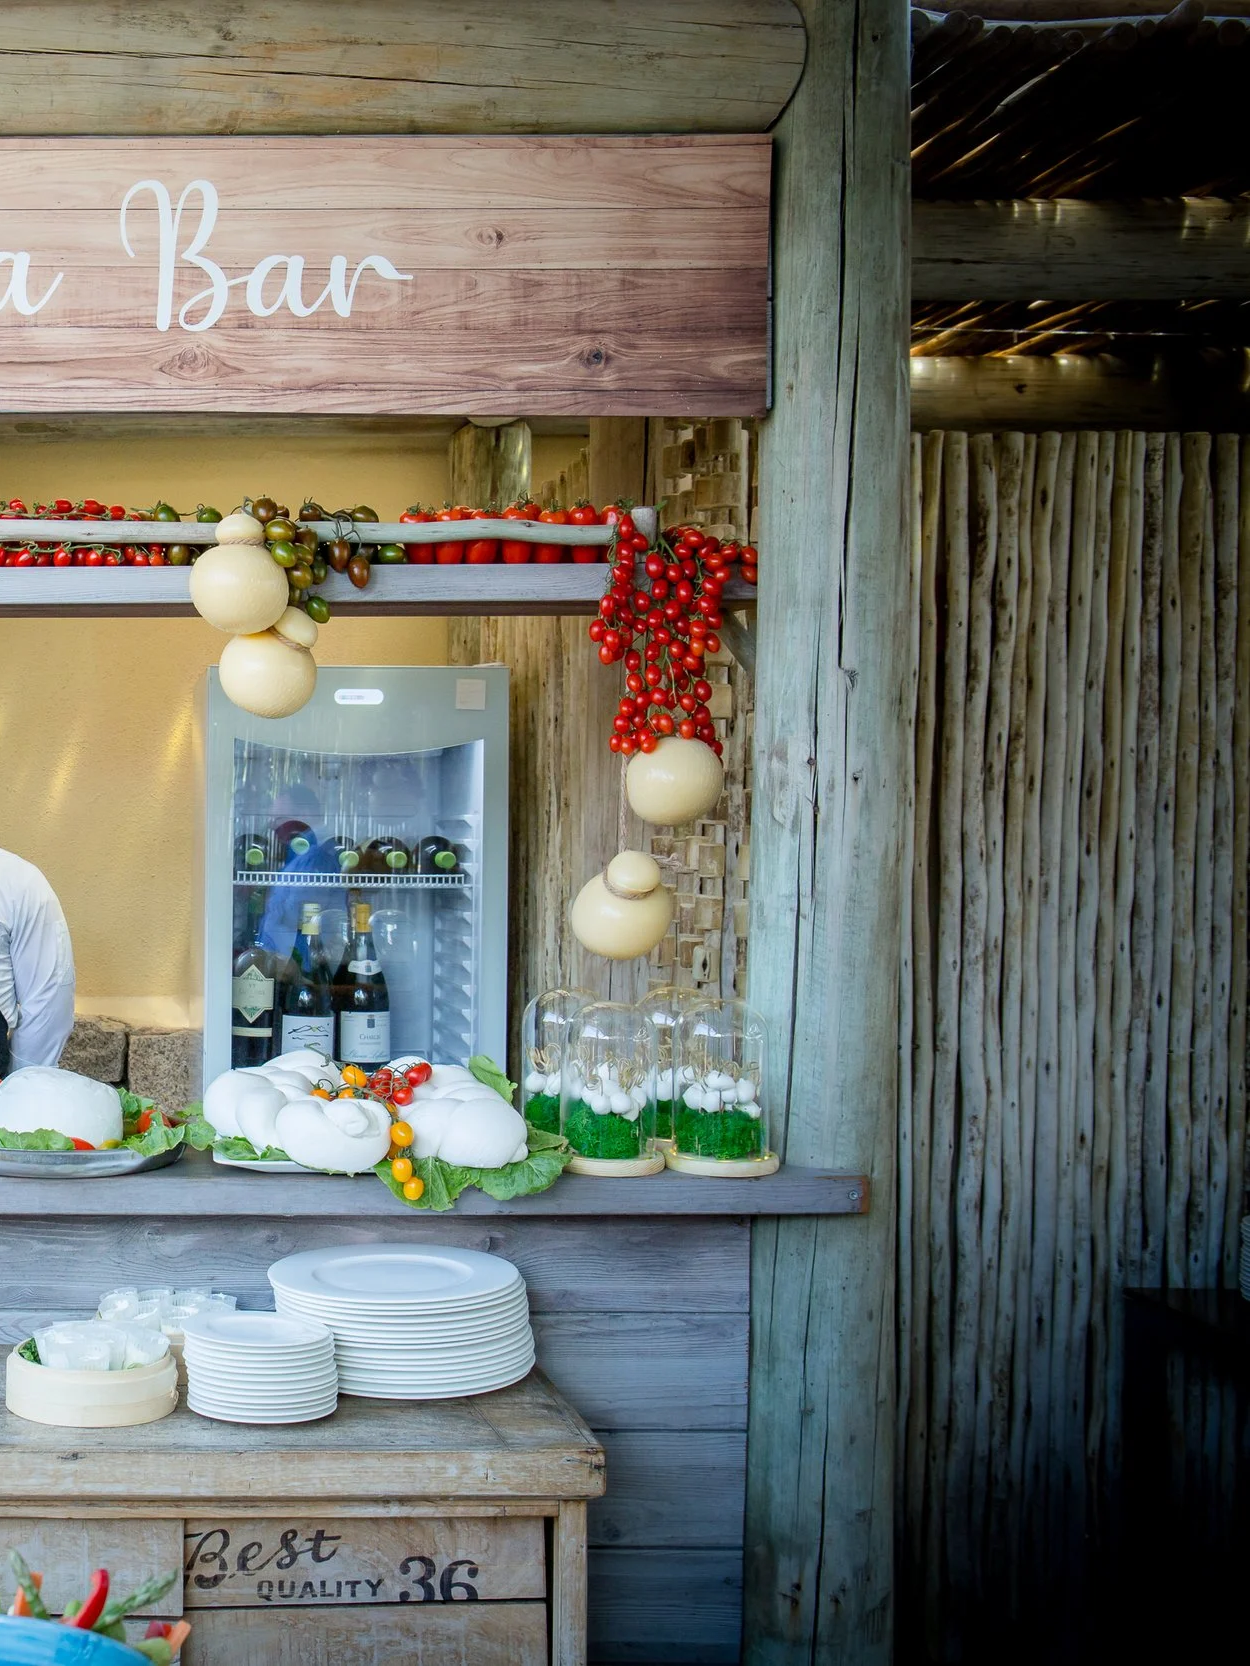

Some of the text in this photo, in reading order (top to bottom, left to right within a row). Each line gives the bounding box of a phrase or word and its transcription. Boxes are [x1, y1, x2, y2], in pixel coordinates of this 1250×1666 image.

[119, 179, 414, 333] Bar
[185, 1528, 341, 1589] Best
[399, 1555, 479, 1602] 36
[256, 1578, 384, 1601] QUALITY
